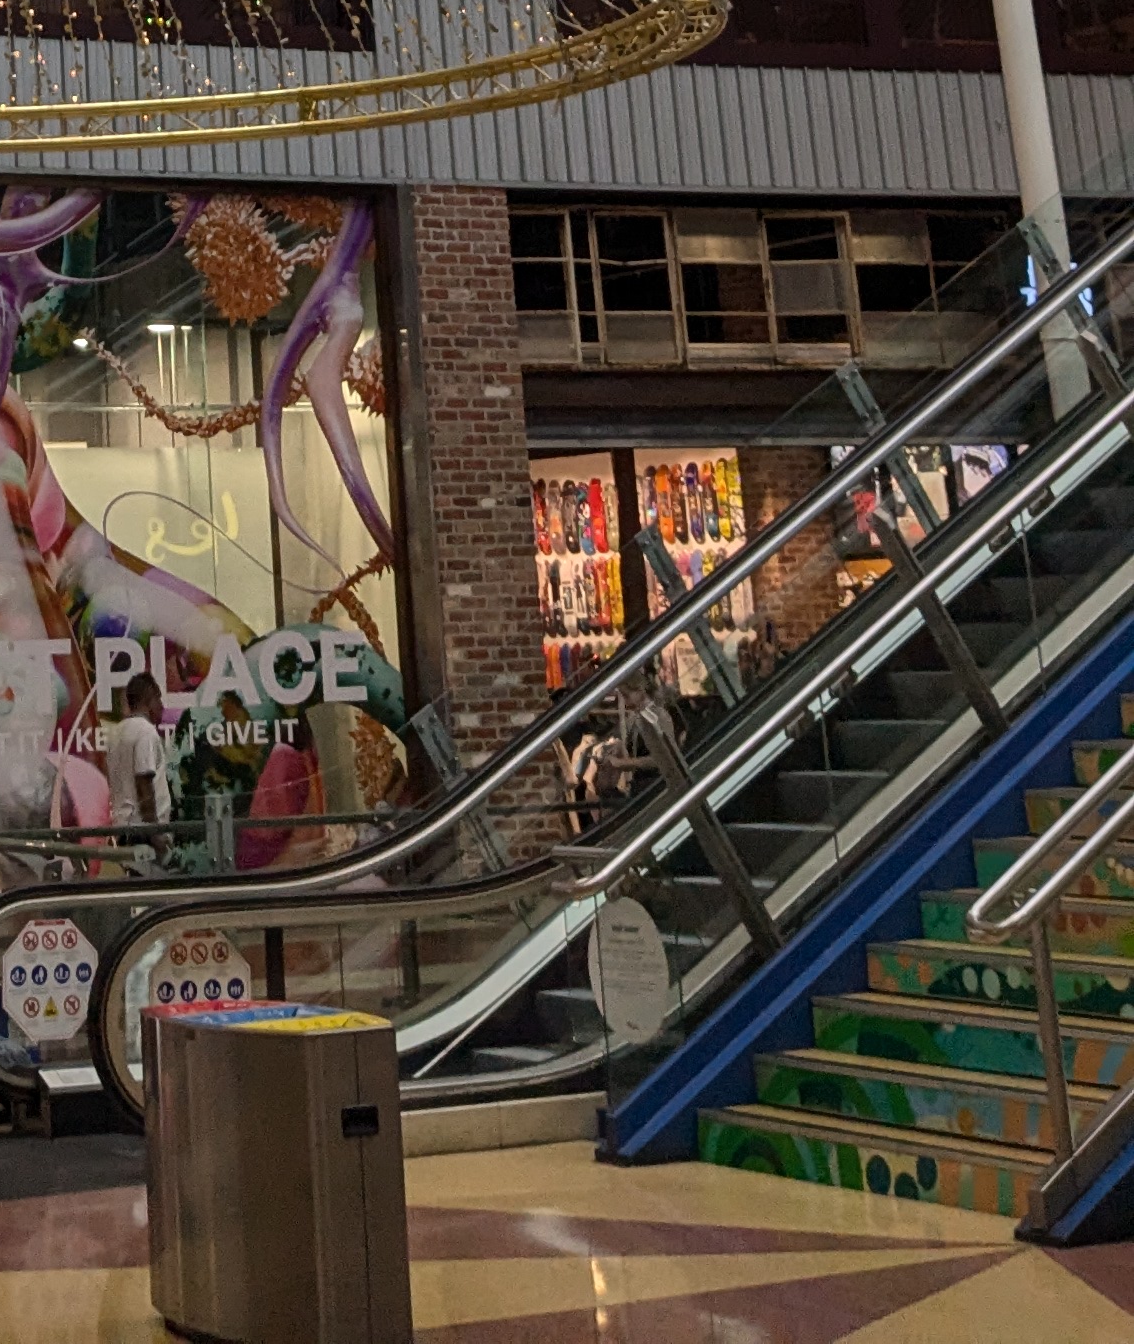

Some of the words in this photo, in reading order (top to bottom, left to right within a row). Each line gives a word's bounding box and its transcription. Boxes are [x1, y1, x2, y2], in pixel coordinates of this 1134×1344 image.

[95, 630, 368, 712] PLACE
[205, 720, 269, 747] GIVE
[274, 717, 299, 745] IT
